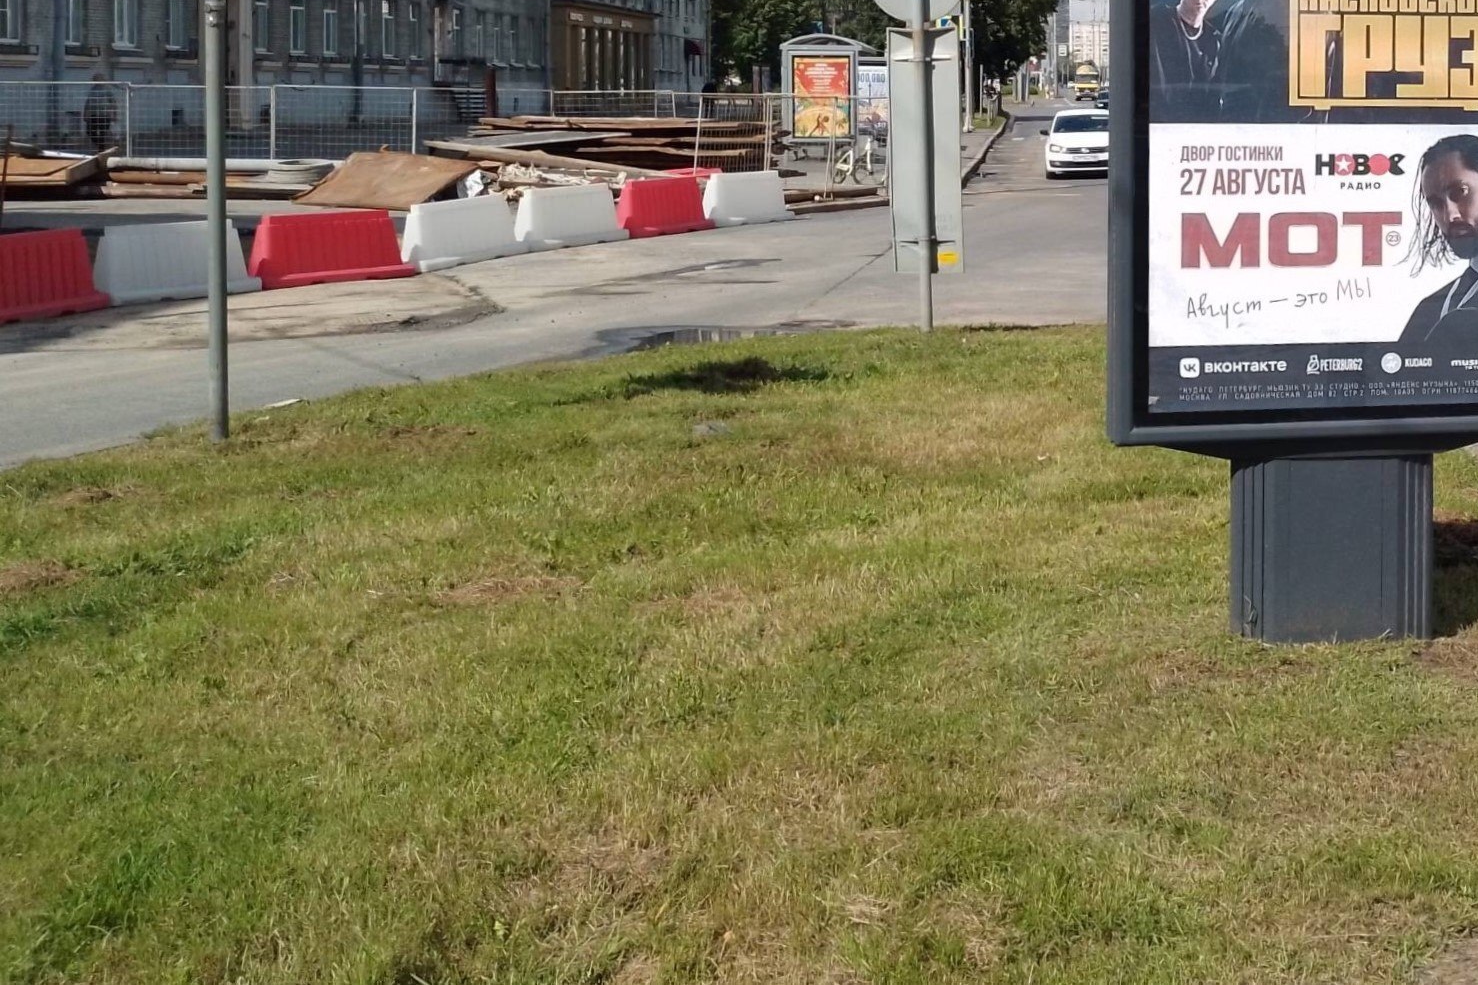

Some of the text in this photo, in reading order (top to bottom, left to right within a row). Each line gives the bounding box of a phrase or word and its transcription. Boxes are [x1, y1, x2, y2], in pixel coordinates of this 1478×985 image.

[1180, 145, 1284, 162] ДВОР ГОСТИНКИ
[1180, 168, 1306, 196] 27 АВГУСТА
[1340, 181, 1382, 191] РАДИО
[1181, 211, 1403, 269] МОТ
[1186, 292, 1262, 329] Август
[1294, 292, 1328, 308] это
[1336, 277, 1372, 302] МЫ
[1404, 357, 1433, 368] KUDAGO
